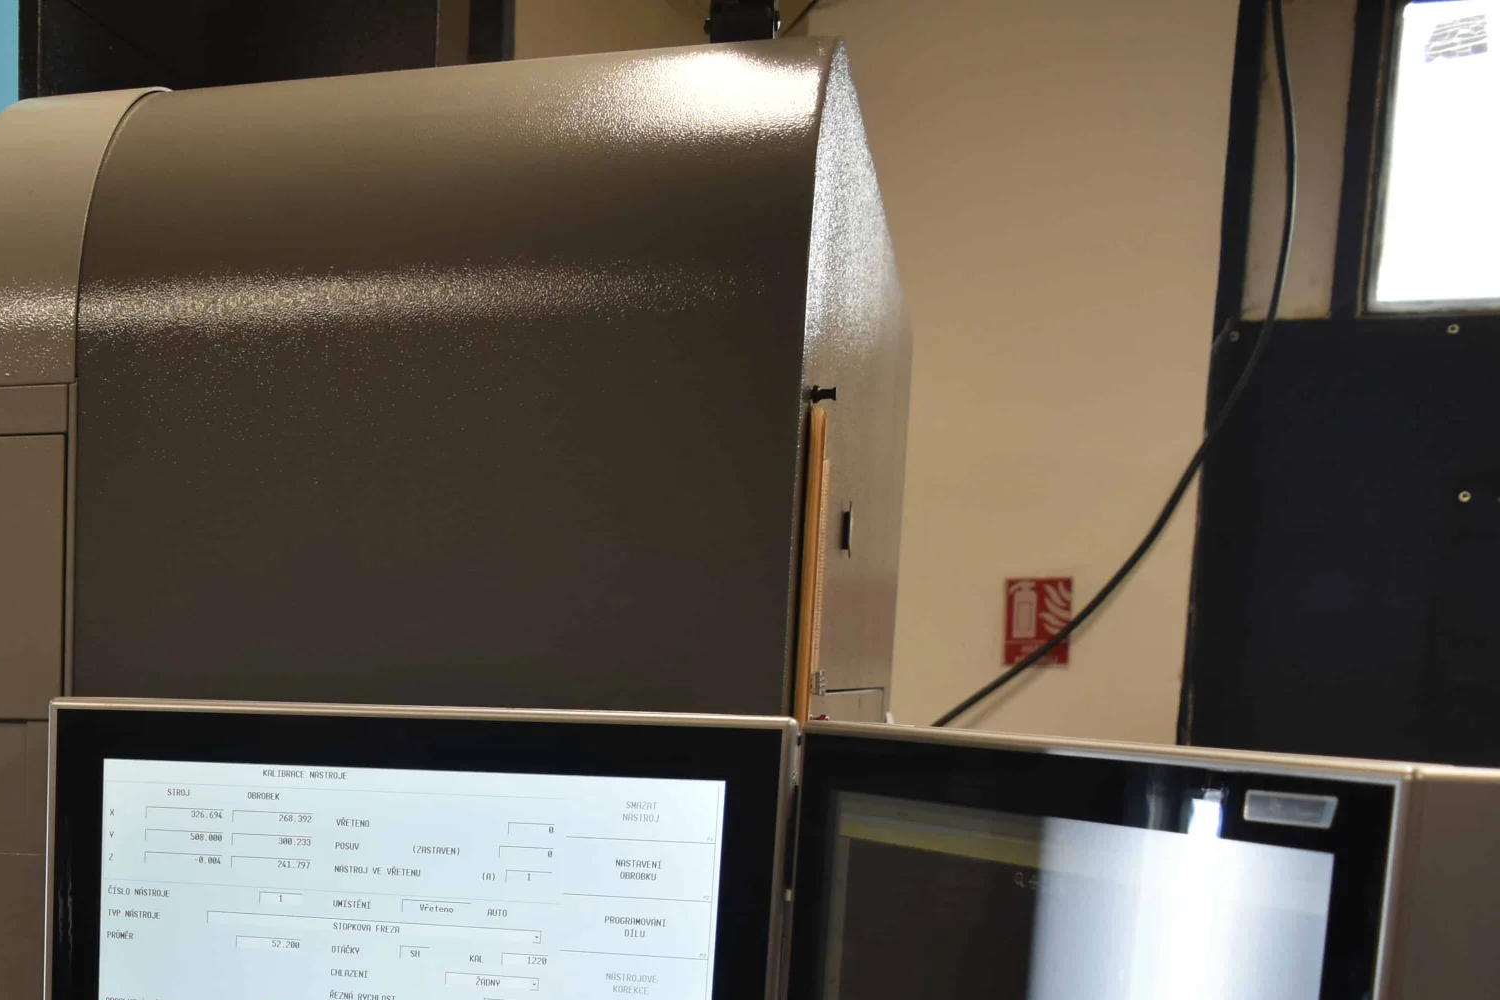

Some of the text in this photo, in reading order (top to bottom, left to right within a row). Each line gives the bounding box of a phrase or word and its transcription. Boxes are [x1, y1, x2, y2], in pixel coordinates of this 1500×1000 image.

[263, 769, 348, 780] KALIBRACE NÁSTROJE
[167, 788, 190, 797] STROJ
[247, 792, 280, 801] OBROBEK
[625, 801, 657, 810] SMAZAT
[109, 808, 115, 816] X
[191, 810, 223, 819] 326.694
[622, 811, 660, 823] NÁSTROJ
[278, 814, 313, 824] 268.392
[336, 817, 370, 828] VŘETENO
[109, 831, 114, 839] Y
[548, 826, 554, 834] 0
[190, 833, 223, 842] 508.000
[278, 837, 312, 847] 300.233
[335, 842, 360, 851] POSUV
[412, 845, 460, 856] (ZASTAVEN)
[108, 853, 114, 861] Z
[547, 850, 553, 858] 0
[194, 856, 221, 865] -0.004
[277, 860, 311, 870] 241.797
[615, 859, 663, 869] NASTAVENÍ
[334, 864, 421, 877] NÁSTROJ VE VŘETENU
[482, 872, 496, 881] (A)
[619, 871, 657, 881] OBROBKU
[107, 884, 170, 898] ČÍSLO NÁSTROJE
[332, 899, 371, 910] UMÍSTĚNÍ
[419, 903, 454, 914] Vřeteno
[107, 909, 161, 920] TYP NÁSTROJE
[487, 908, 508, 918] AUTO
[604, 915, 669, 927] PROGRAMOVÁNÍ
[332, 922, 400, 934] STOPKOVA FREZA
[624, 928, 646, 938] DÍLU
[106, 930, 134, 940] PRŮMĚR
[271, 939, 300, 949] 52.200
[331, 944, 360, 955] OTÁČKY
[469, 954, 484, 963] KAL
[526, 956, 547, 965] 1220
[330, 968, 369, 979] CHLAZENÍ
[605, 971, 658, 984] NÁSTROJOVÉ
[475, 976, 501, 987] ŽÁDNÝ
[329, 990, 354, 1000] ŘEZNÁ
[612, 985, 649, 995] KOREKCE
